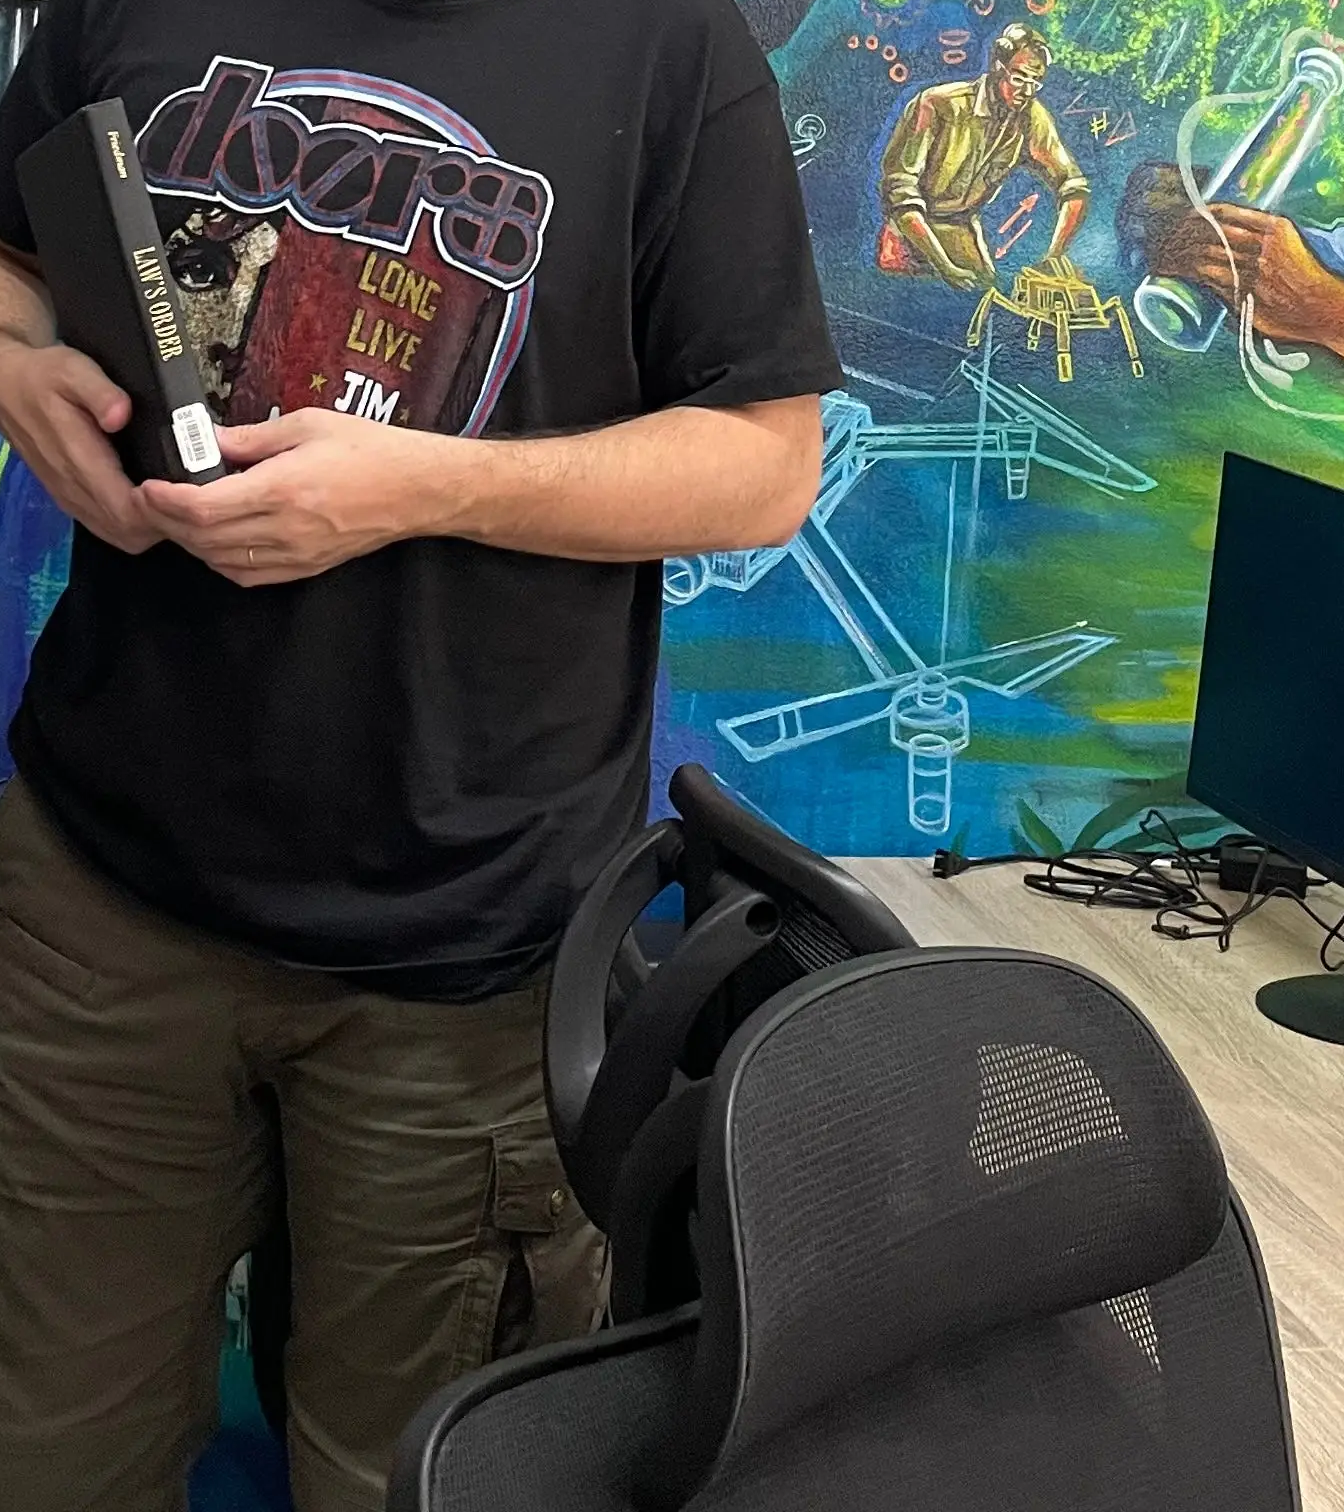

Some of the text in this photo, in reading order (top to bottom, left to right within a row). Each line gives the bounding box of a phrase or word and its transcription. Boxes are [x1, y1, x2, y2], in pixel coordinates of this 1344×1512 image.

[107, 131, 128, 179] Friedman
[136, 56, 554, 288] doors
[133, 246, 184, 363] LAW'S ORDER
[358, 251, 443, 322] LONG
[346, 308, 424, 373] LIVE
[334, 370, 401, 425] JIM
